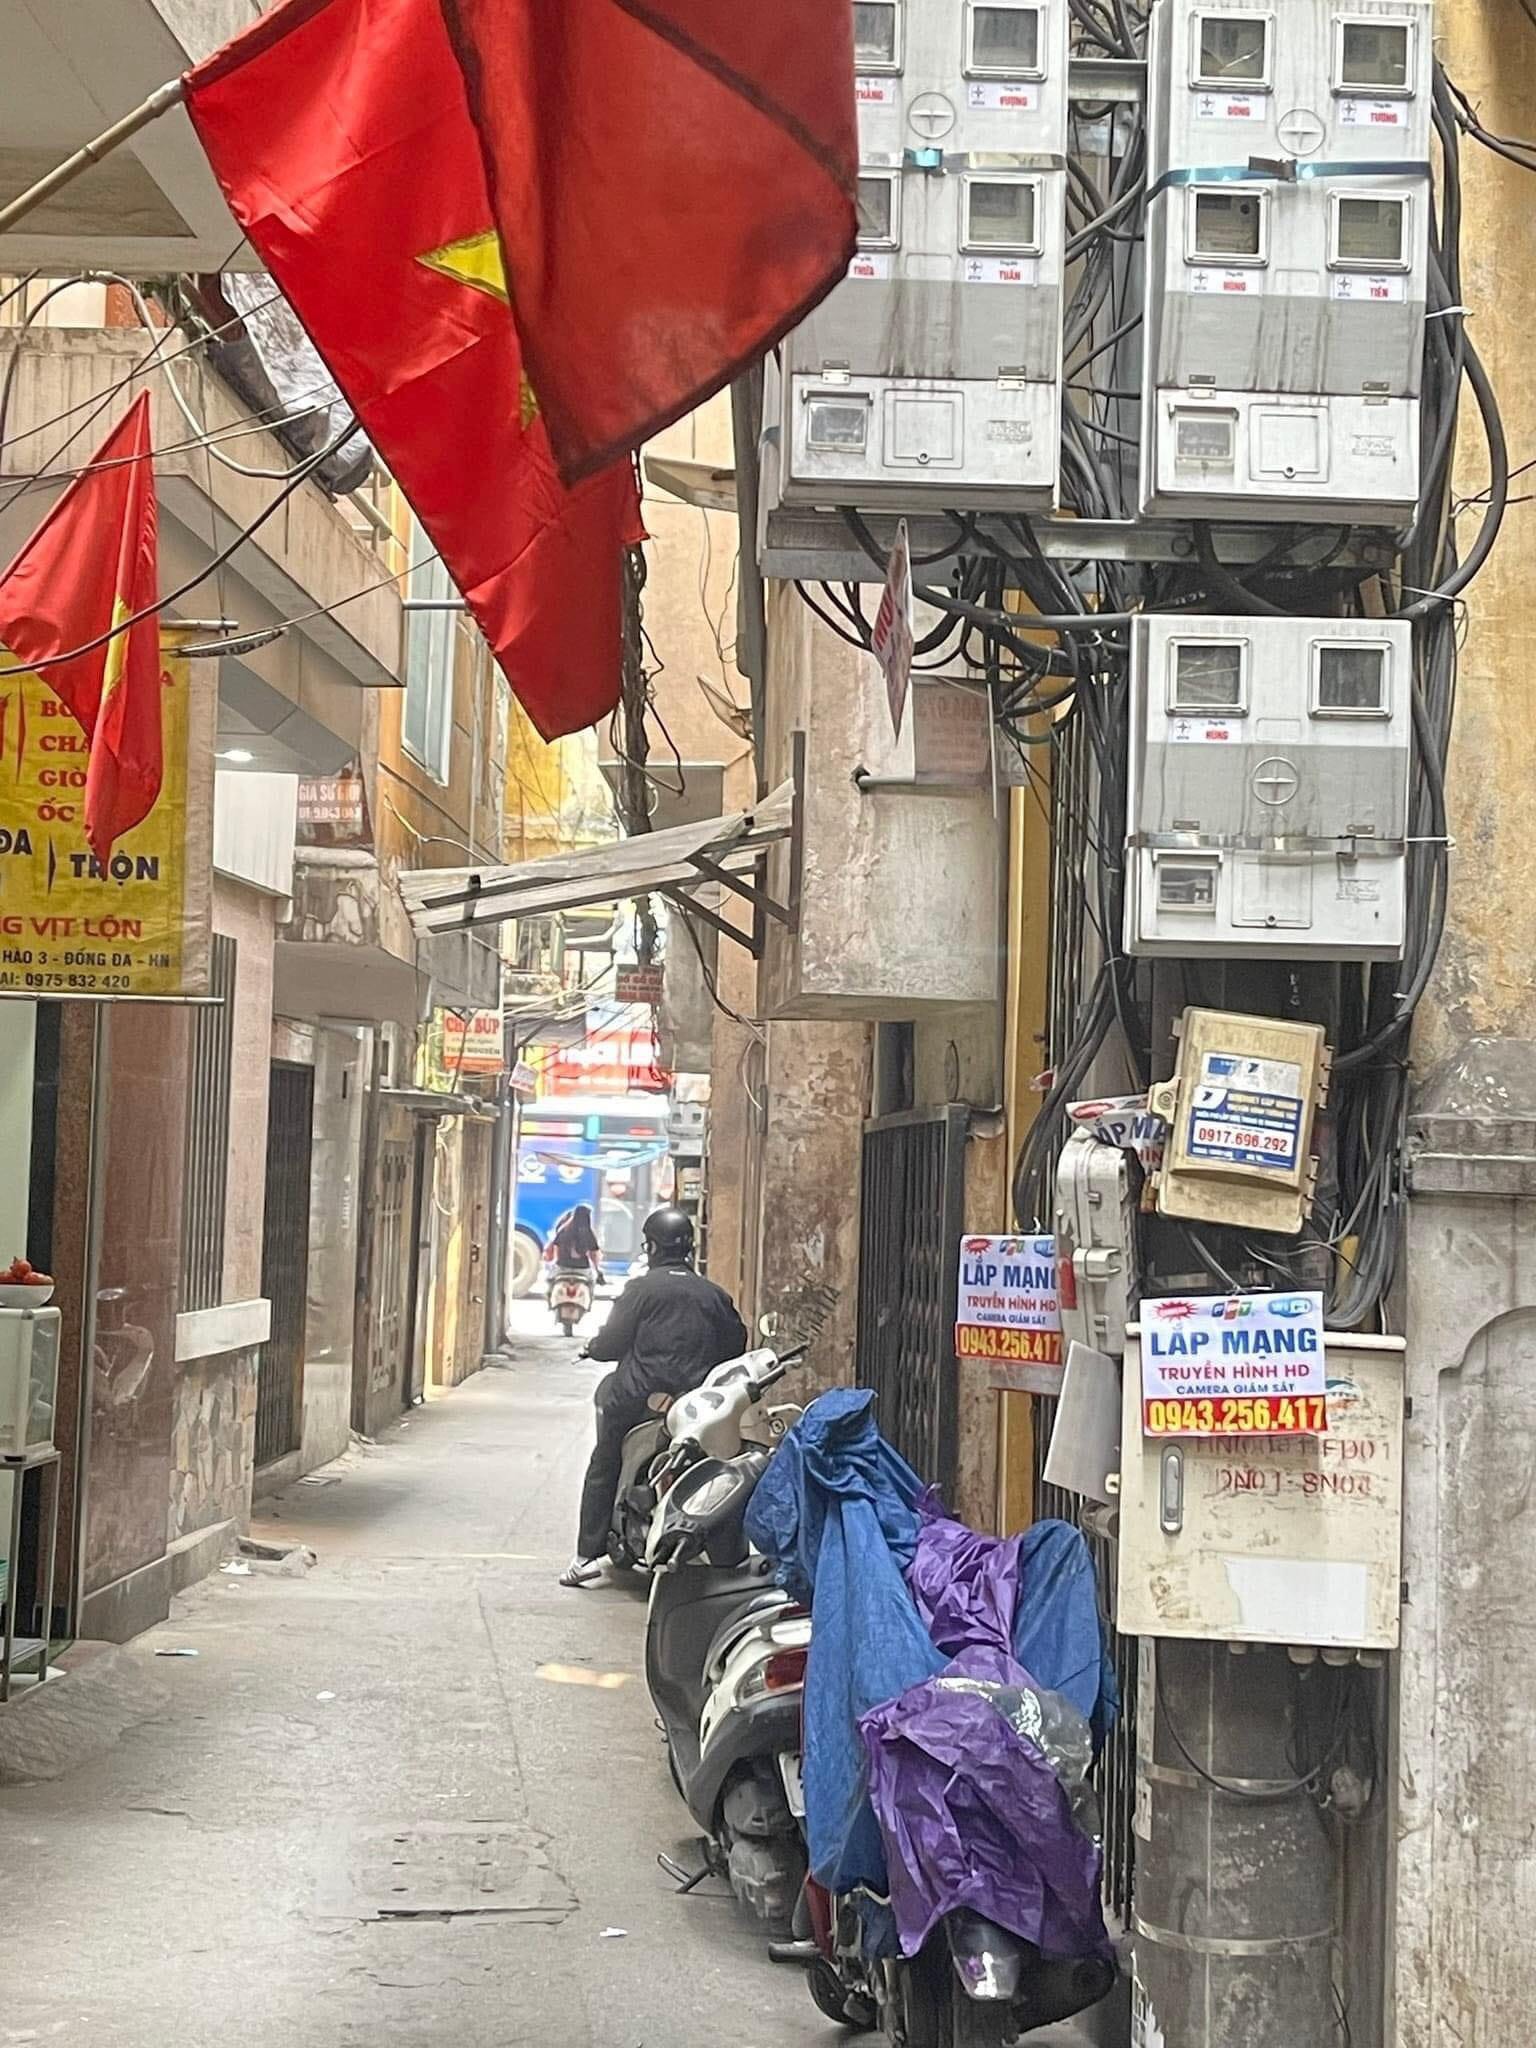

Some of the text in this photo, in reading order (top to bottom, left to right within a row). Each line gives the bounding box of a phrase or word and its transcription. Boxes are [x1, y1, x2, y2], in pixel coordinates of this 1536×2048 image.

[30, 917, 75, 941] VỊT
[83, 914, 142, 942] LỘN
[38, 951, 48, 964] 3
[25, 973, 63, 986] 0975
[68, 974, 96, 988] 832
[101, 975, 130, 988] 420
[1003, 1265, 1057, 1294] MẠN
[959, 1326, 1061, 1362] 0943.256.417
[1150, 1323, 1317, 1360] LẮP MẠNG
[1158, 1360, 1310, 1380] TRUYỀN HÌNH HD
[1176, 1385, 1229, 1395] CAMERA
[1234, 1383, 1268, 1394] GIÁM
[1149, 1397, 1325, 1433] 0943.256.417
